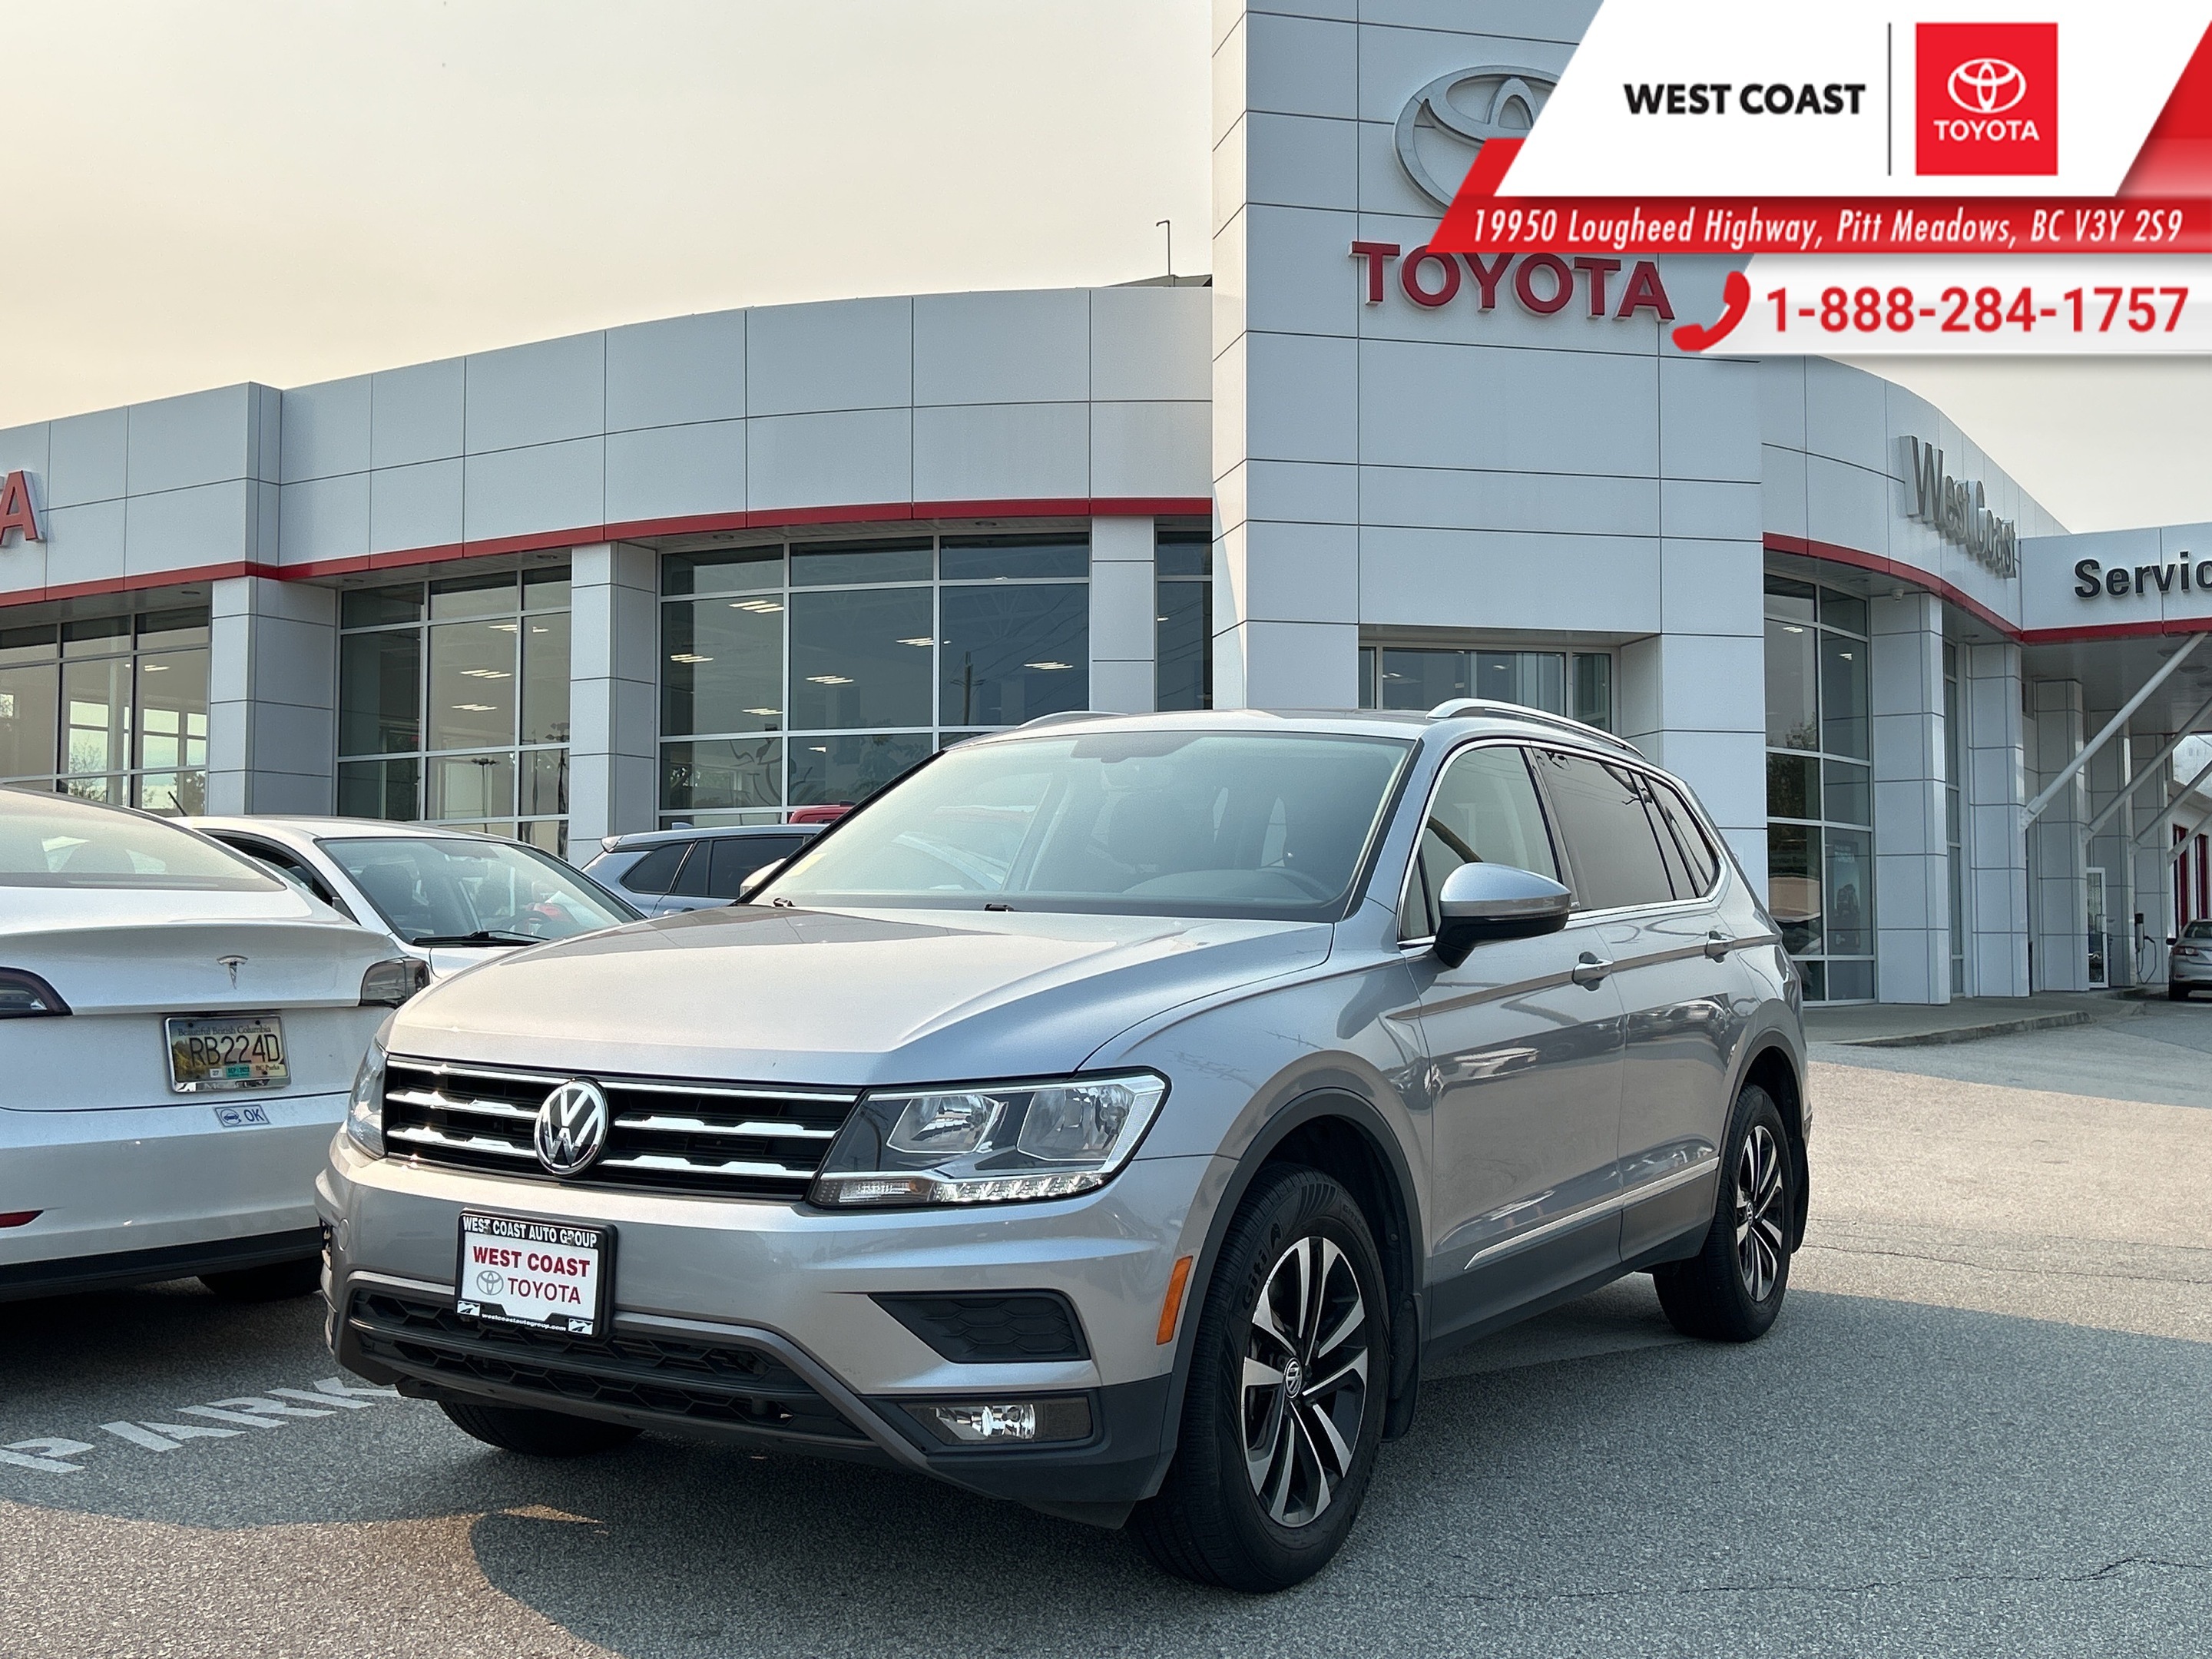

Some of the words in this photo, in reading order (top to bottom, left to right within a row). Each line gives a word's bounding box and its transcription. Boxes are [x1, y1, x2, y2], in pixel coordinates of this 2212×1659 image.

[1349, 240, 1675, 323] TOYOTA
[1900, 435, 1971, 545] West
[1967, 480, 2017, 579] Coast
[177, 1026, 210, 1036] Beautiful
[212, 1025, 236, 1035] British
[237, 1023, 272, 1034] Columbia
[189, 1033, 281, 1068] RB224D
[243, 1108, 265, 1123] OK
[492, 1220, 527, 1238] COAST
[528, 1225, 557, 1243] AUTO
[473, 1246, 522, 1268] WEST
[527, 1253, 591, 1277] COAST
[507, 1277, 581, 1305] TOYOTA
[481, 1312, 567, 1332] westcoastautogroup.com
